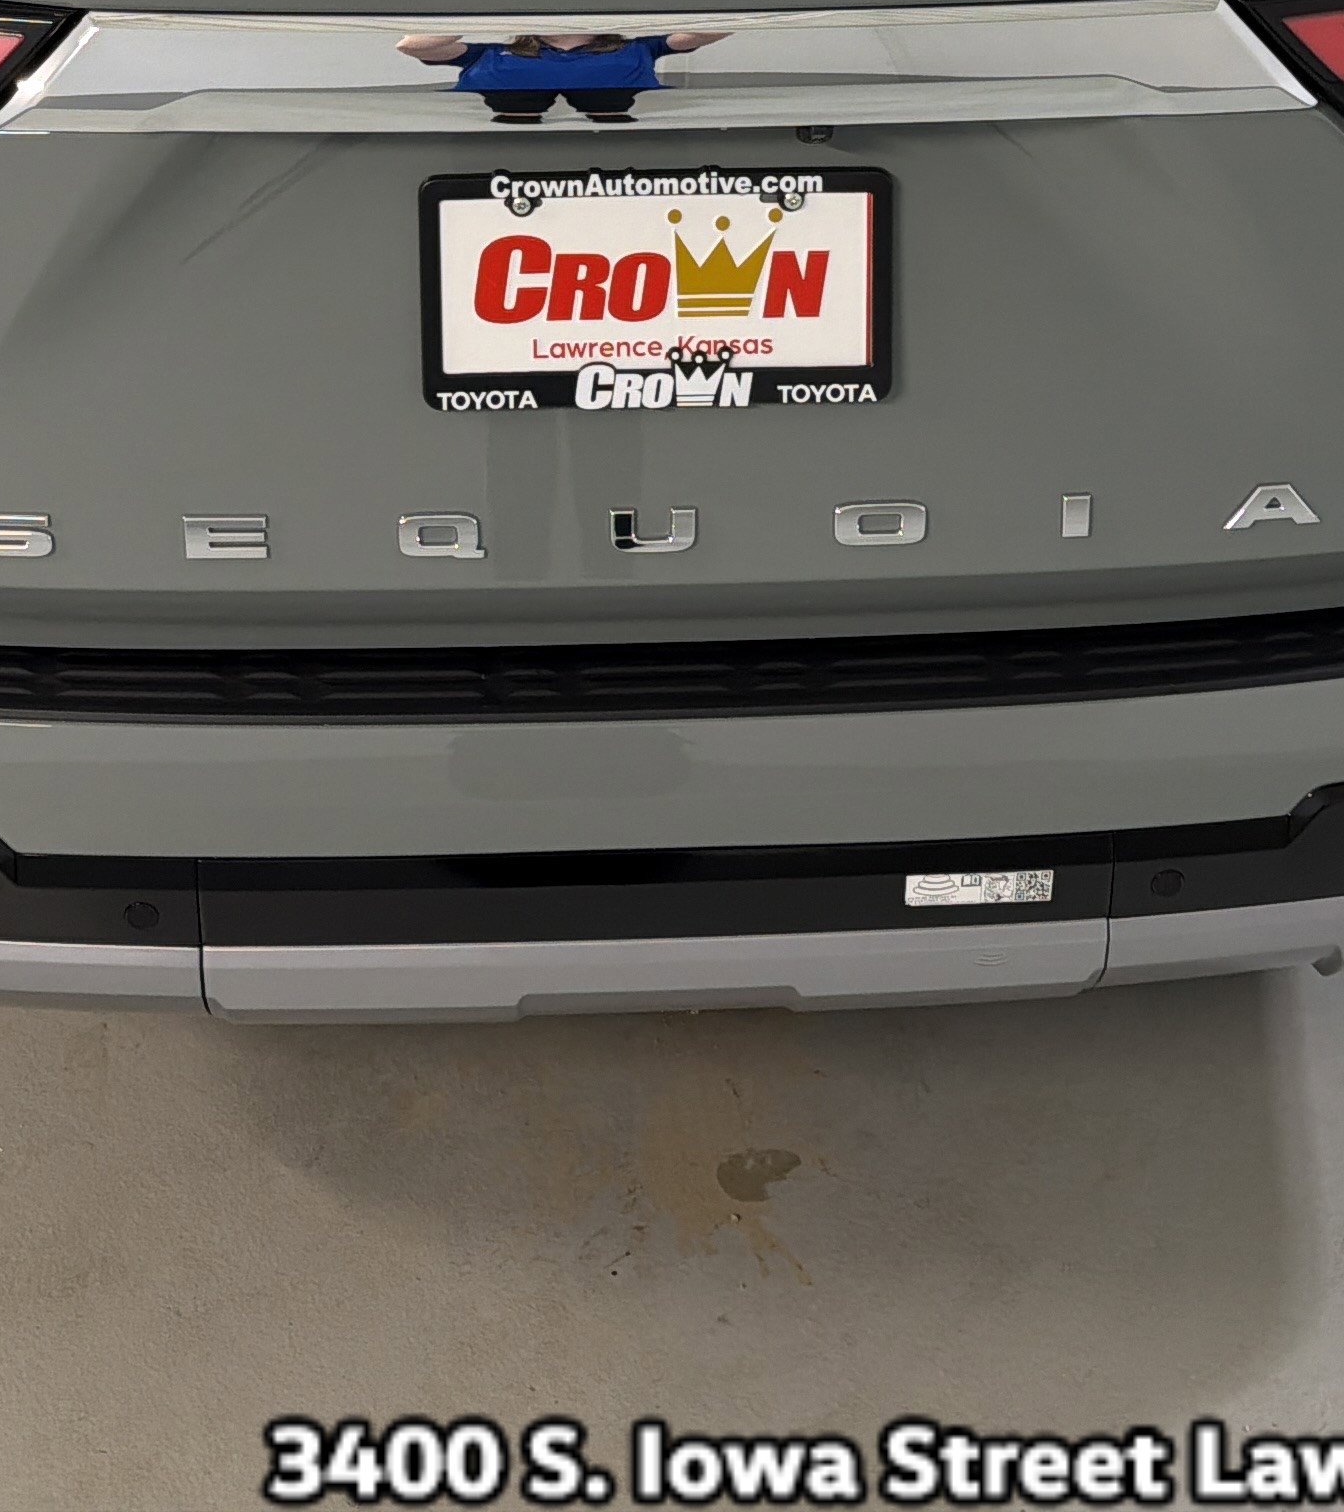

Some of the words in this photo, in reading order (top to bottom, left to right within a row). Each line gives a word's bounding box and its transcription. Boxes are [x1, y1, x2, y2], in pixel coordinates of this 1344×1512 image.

[490, 171, 824, 200] CrownAutomotive.com
[474, 209, 830, 324] CROWN
[532, 336, 670, 361] Lawrence,
[677, 335, 774, 358] Kansas
[436, 391, 538, 411] TOYOTA
[574, 349, 754, 410] CROWN
[776, 383, 878, 405] TOYOTA
